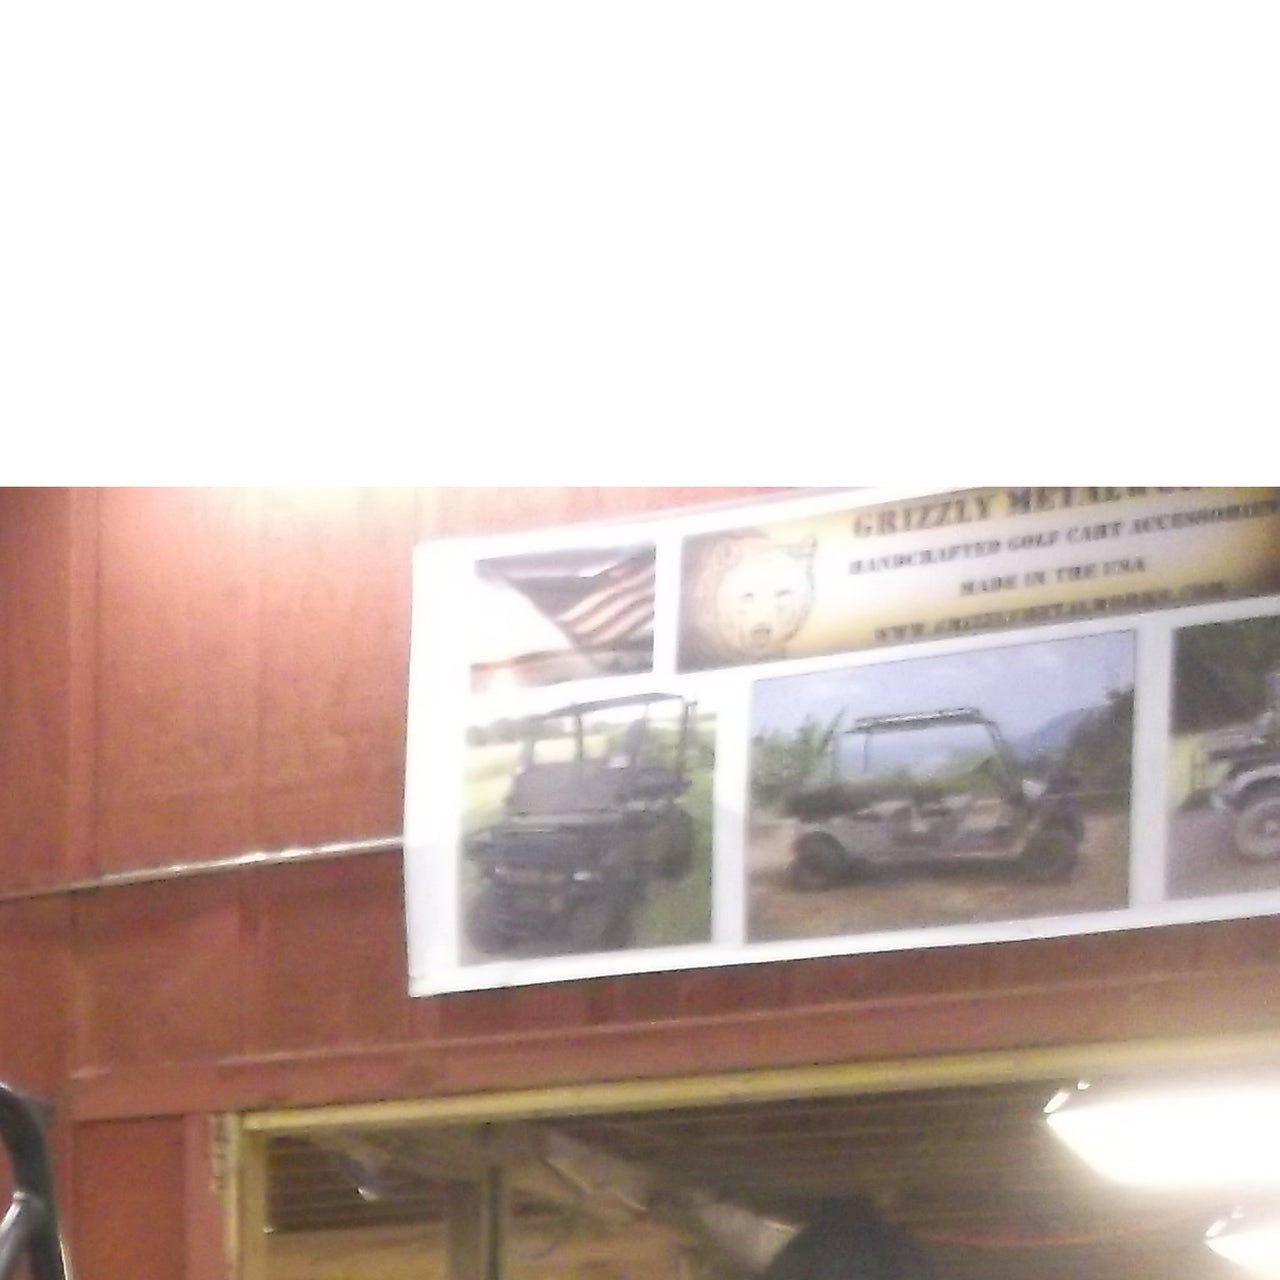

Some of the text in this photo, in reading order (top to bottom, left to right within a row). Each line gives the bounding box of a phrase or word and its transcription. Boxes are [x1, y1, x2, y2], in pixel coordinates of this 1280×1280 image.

[853, 496, 991, 537] GRIZZLY
[849, 541, 1000, 574] HANDCRAFTED
[1008, 530, 1059, 549] GOLF
[1067, 522, 1122, 543] CART
[961, 557, 1145, 595] MADE IN THE USA
